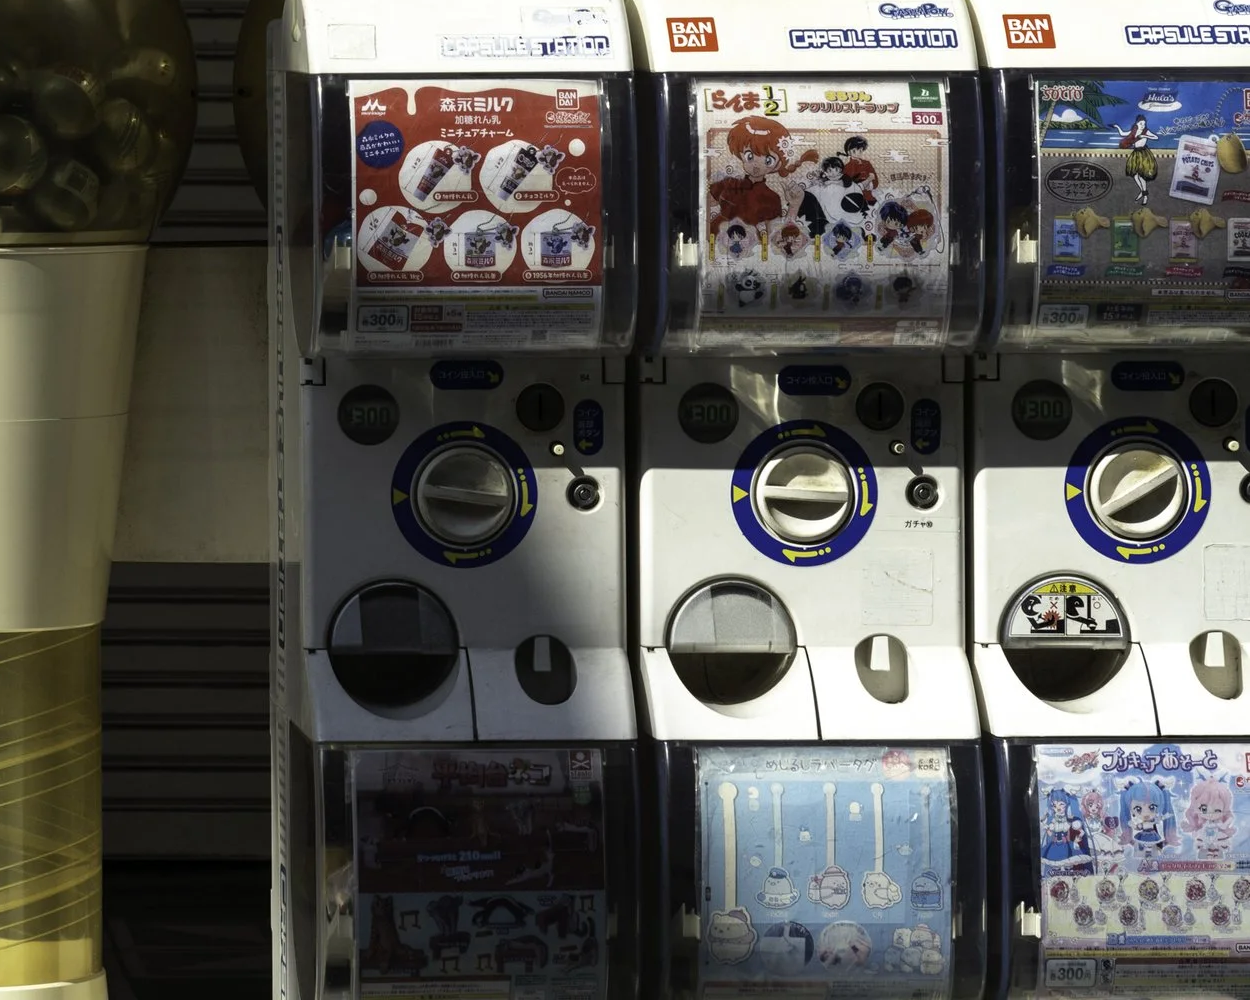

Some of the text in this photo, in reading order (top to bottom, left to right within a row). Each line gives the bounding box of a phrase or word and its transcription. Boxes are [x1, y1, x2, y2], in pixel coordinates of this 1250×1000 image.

[671, 22, 712, 35] BAN
[1007, 18, 1049, 31] BAN
[673, 35, 706, 47] DAI
[790, 30, 957, 49] CAPSULE STATION
[1009, 31, 1043, 44] DAI
[1125, 26, 1214, 45] CAPSULE
[531, 36, 610, 57] STATION
[558, 91, 577, 100] BAN
[711, 90, 760, 114] らんま
[1147, 93, 1175, 102] Hula's
[440, 97, 514, 113] 森永ミルク
[558, 99, 574, 107] DAI
[797, 102, 899, 115] アクリルストラップ
[455, 115, 502, 126] 加糖れん乳
[440, 128, 514, 138] ミニチュアチャーム
[1060, 167, 1096, 180] フラ印
[1065, 189, 1093, 197] チャーム
[1059, 584, 1077, 593] 注意
[766, 757, 878, 773] めじるしラバータグ
[1103, 747, 1218, 774] プリキュアあそーと
